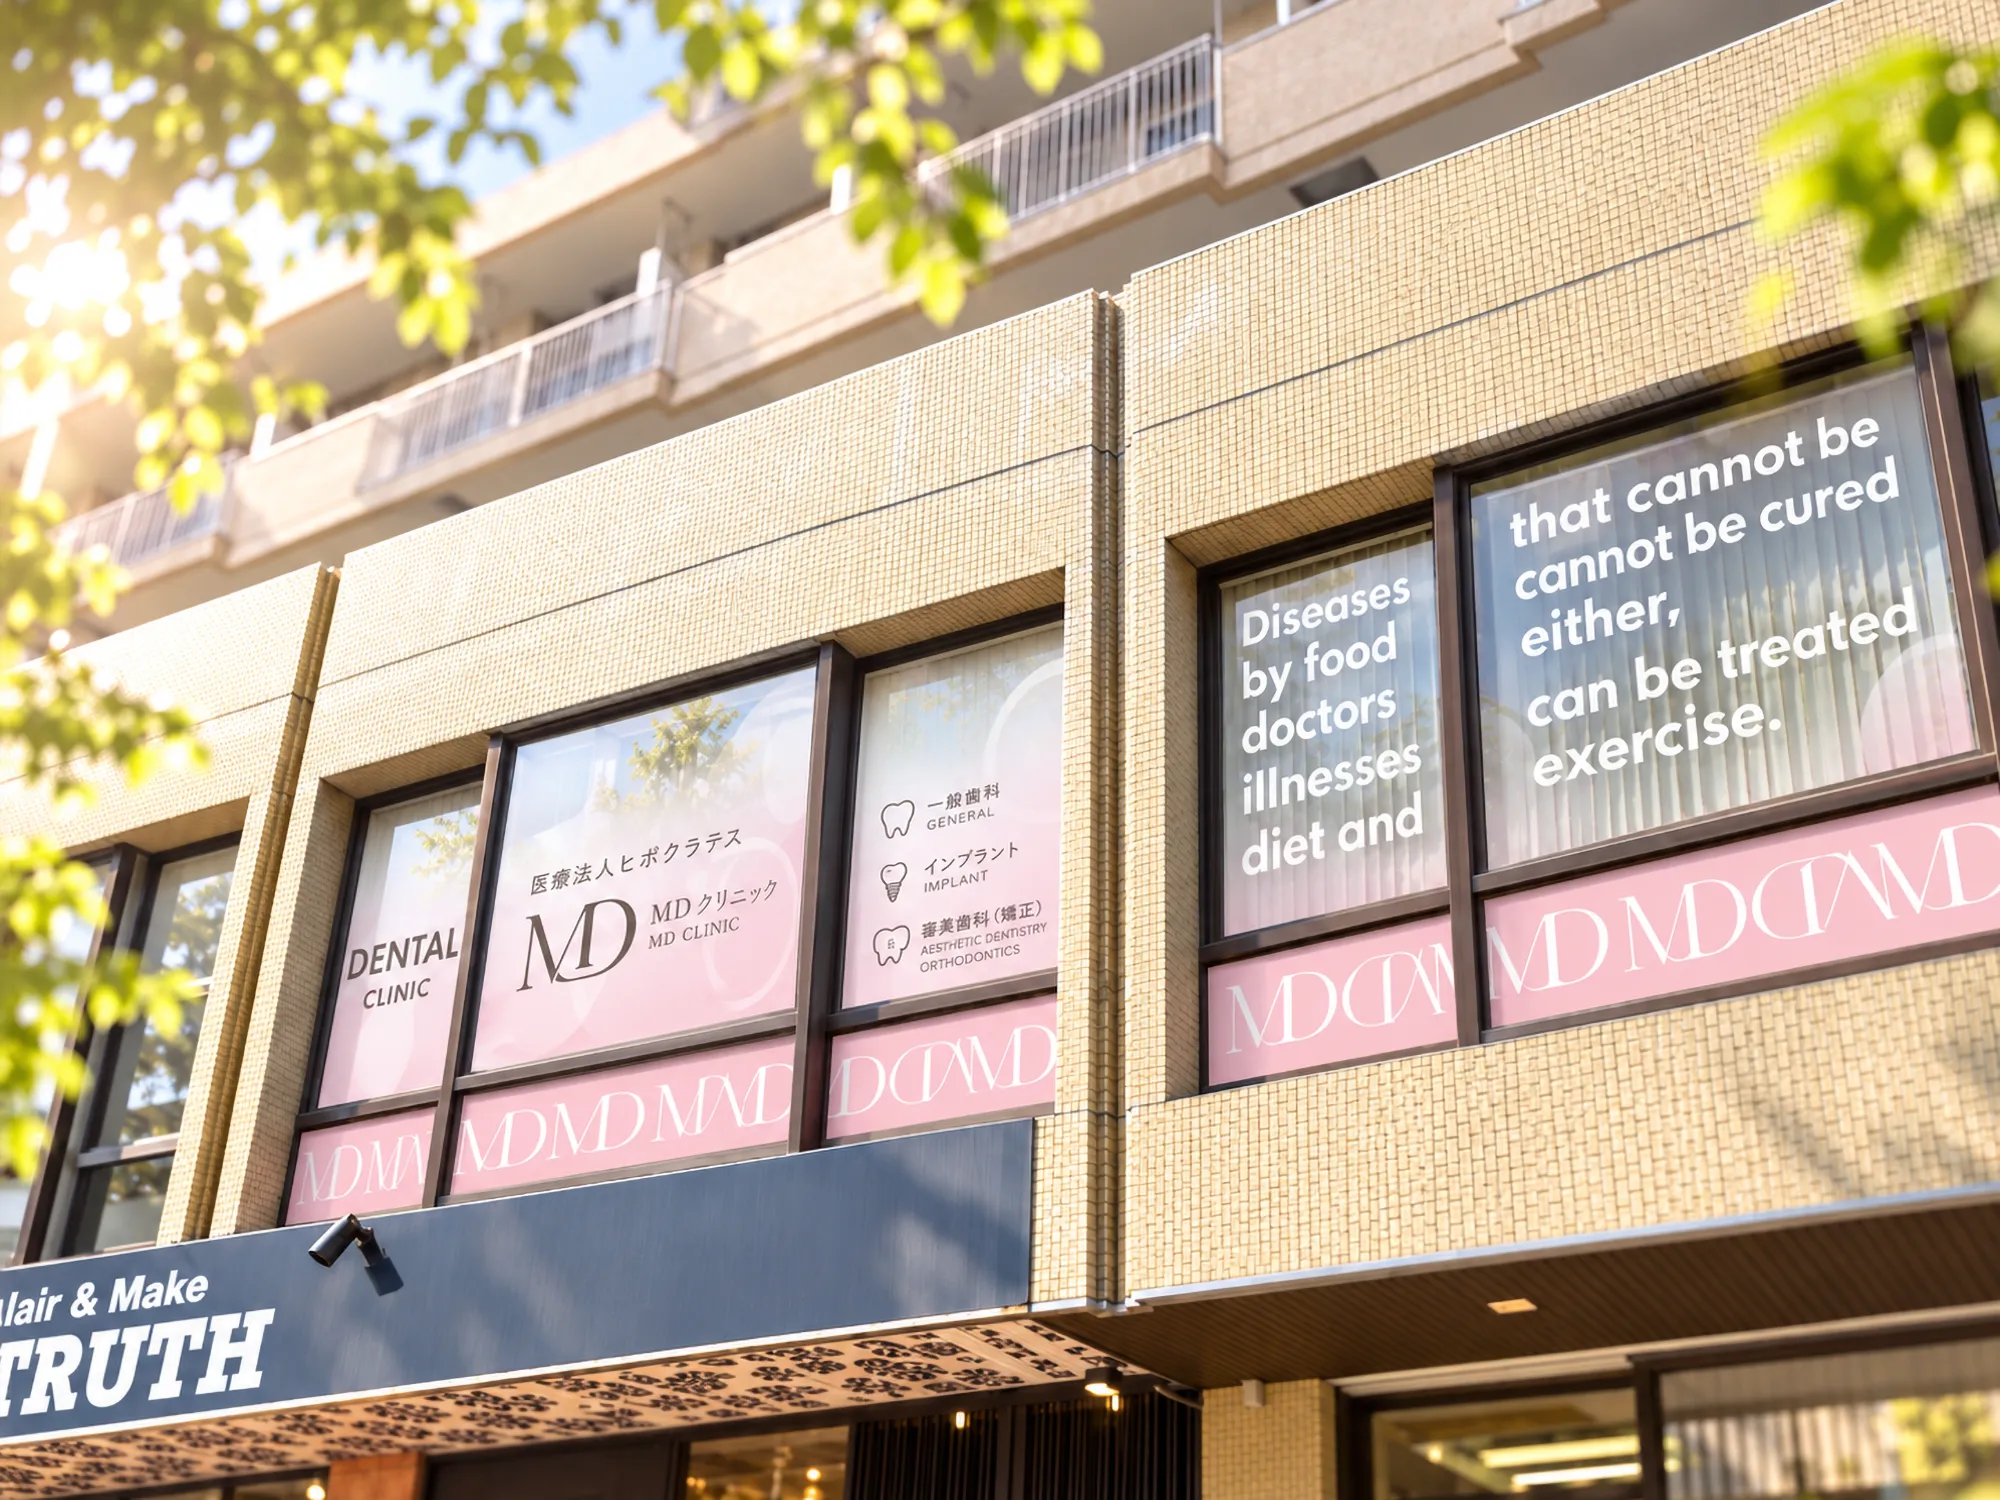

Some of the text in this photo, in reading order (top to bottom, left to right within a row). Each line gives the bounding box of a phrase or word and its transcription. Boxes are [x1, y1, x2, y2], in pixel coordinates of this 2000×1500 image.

[1509, 415, 1881, 548] that cannot be
[1514, 455, 1901, 601] cannot be cured
[1241, 574, 1412, 647] Diseases
[1520, 587, 1682, 658] either,
[1241, 621, 1398, 702] by food
[1527, 586, 1919, 729] can be treated
[1241, 683, 1398, 755] doctors
[1532, 702, 1782, 788] exercise.
[1241, 737, 1423, 816] illnesses
[927, 807, 995, 831] GENERAL
[1241, 790, 1424, 876] diet and
[924, 869, 988, 893] IMPLANT
[347, 927, 459, 980] DENTAL
[516, 898, 637, 992] MD
[648, 916, 740, 950] MD CLINIC
[919, 944, 1020, 973] ORTHODONTICS
[920, 922, 1047, 957] AESTHETIC DENTISTRY
[1618, 878, 1747, 972] MD
[363, 977, 431, 1009] CLINIC
[70, 1281, 98, 1319] &
[108, 1269, 209, 1314] Make
